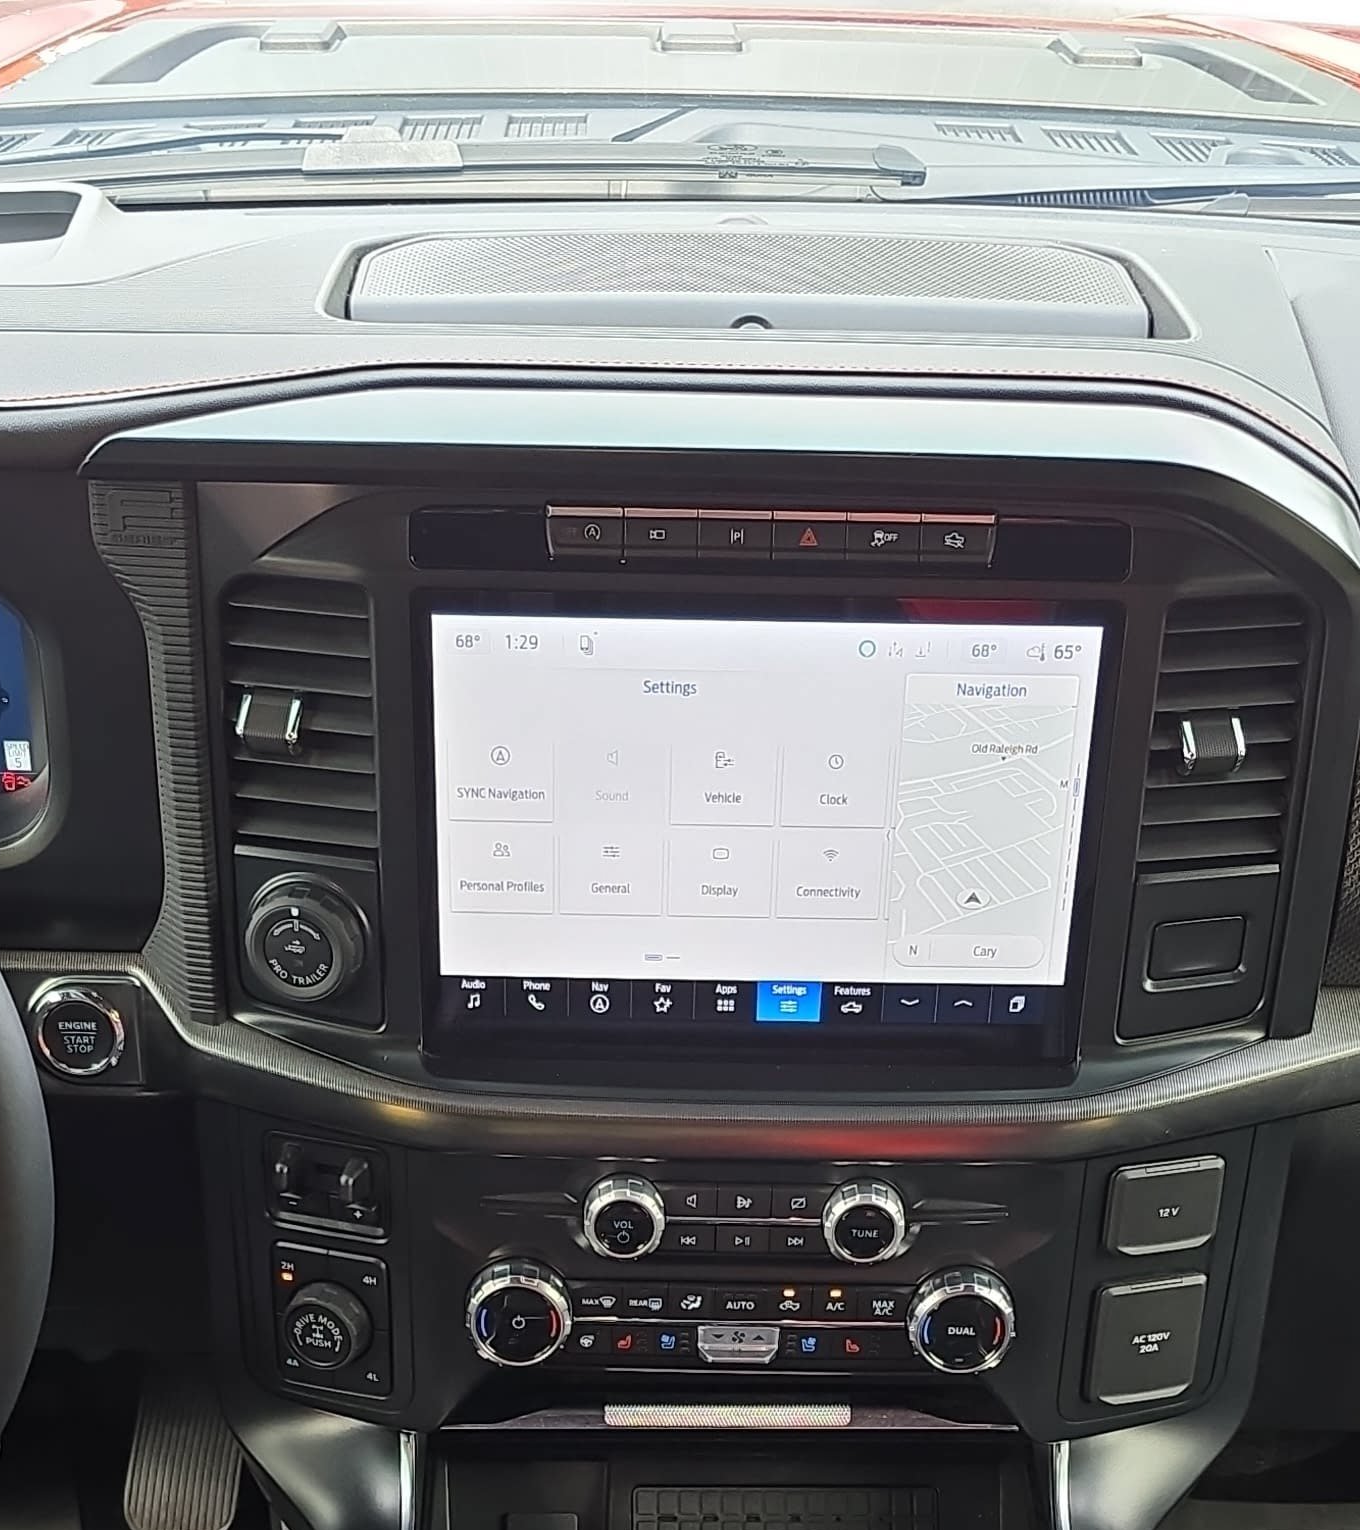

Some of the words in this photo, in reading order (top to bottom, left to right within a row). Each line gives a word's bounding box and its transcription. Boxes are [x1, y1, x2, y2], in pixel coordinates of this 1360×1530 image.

[884, 533, 899, 542] OFF
[505, 634, 538, 650] 1:29
[643, 680, 697, 697] Settings
[956, 683, 1027, 699] Navigation
[971, 743, 988, 754] Old
[989, 744, 1024, 756] Raleigh
[1025, 744, 1038, 754] Rd
[15, 758, 22, 768] 5
[457, 787, 486, 799] SYNC
[488, 787, 545, 802] Navigation
[595, 789, 629, 802] Sound
[704, 791, 742, 804] Vehicle
[819, 793, 848, 806] Clock
[459, 879, 504, 892] Personal
[506, 880, 545, 893] Profiles
[591, 882, 630, 894] General
[701, 884, 738, 898] Display
[796, 886, 861, 900] Connectivity
[909, 945, 918, 956] N
[973, 945, 997, 959] Cary
[269, 959, 289, 980] PRO
[291, 963, 329, 985] TRAILER
[461, 978, 486, 989] Audio
[522, 980, 551, 991] Phone
[591, 981, 609, 992] Nav
[655, 983, 671, 993] Fav
[715, 984, 738, 996] Apps
[771, 984, 808, 996] Settings
[834, 986, 872, 996] Features
[58, 1021, 98, 1031] ENGINE
[63, 1035, 96, 1045] START
[66, 1044, 94, 1054] STOP
[1158, 1208, 1172, 1218] 12
[1171, 1207, 1180, 1217] V
[613, 1220, 634, 1229] VOL
[851, 1228, 879, 1239] TUNE
[280, 1260, 295, 1271] 2H
[362, 1275, 377, 1286] 4H
[581, 1297, 599, 1306] MAX
[628, 1299, 648, 1308] REAR
[726, 1300, 755, 1311] AUTO
[825, 1301, 845, 1312] A/C
[872, 1301, 895, 1309] MAX
[873, 1307, 893, 1316] A/C
[294, 1314, 316, 1336] DRIVE
[318, 1314, 343, 1341] MODE
[947, 1326, 976, 1336] DUAL
[305, 1336, 332, 1349] PUSH
[1131, 1333, 1147, 1345] AC
[1148, 1332, 1170, 1343] 120V
[1139, 1343, 1159, 1354] 20A
[286, 1358, 299, 1367] 4A
[366, 1372, 380, 1382] 4L
